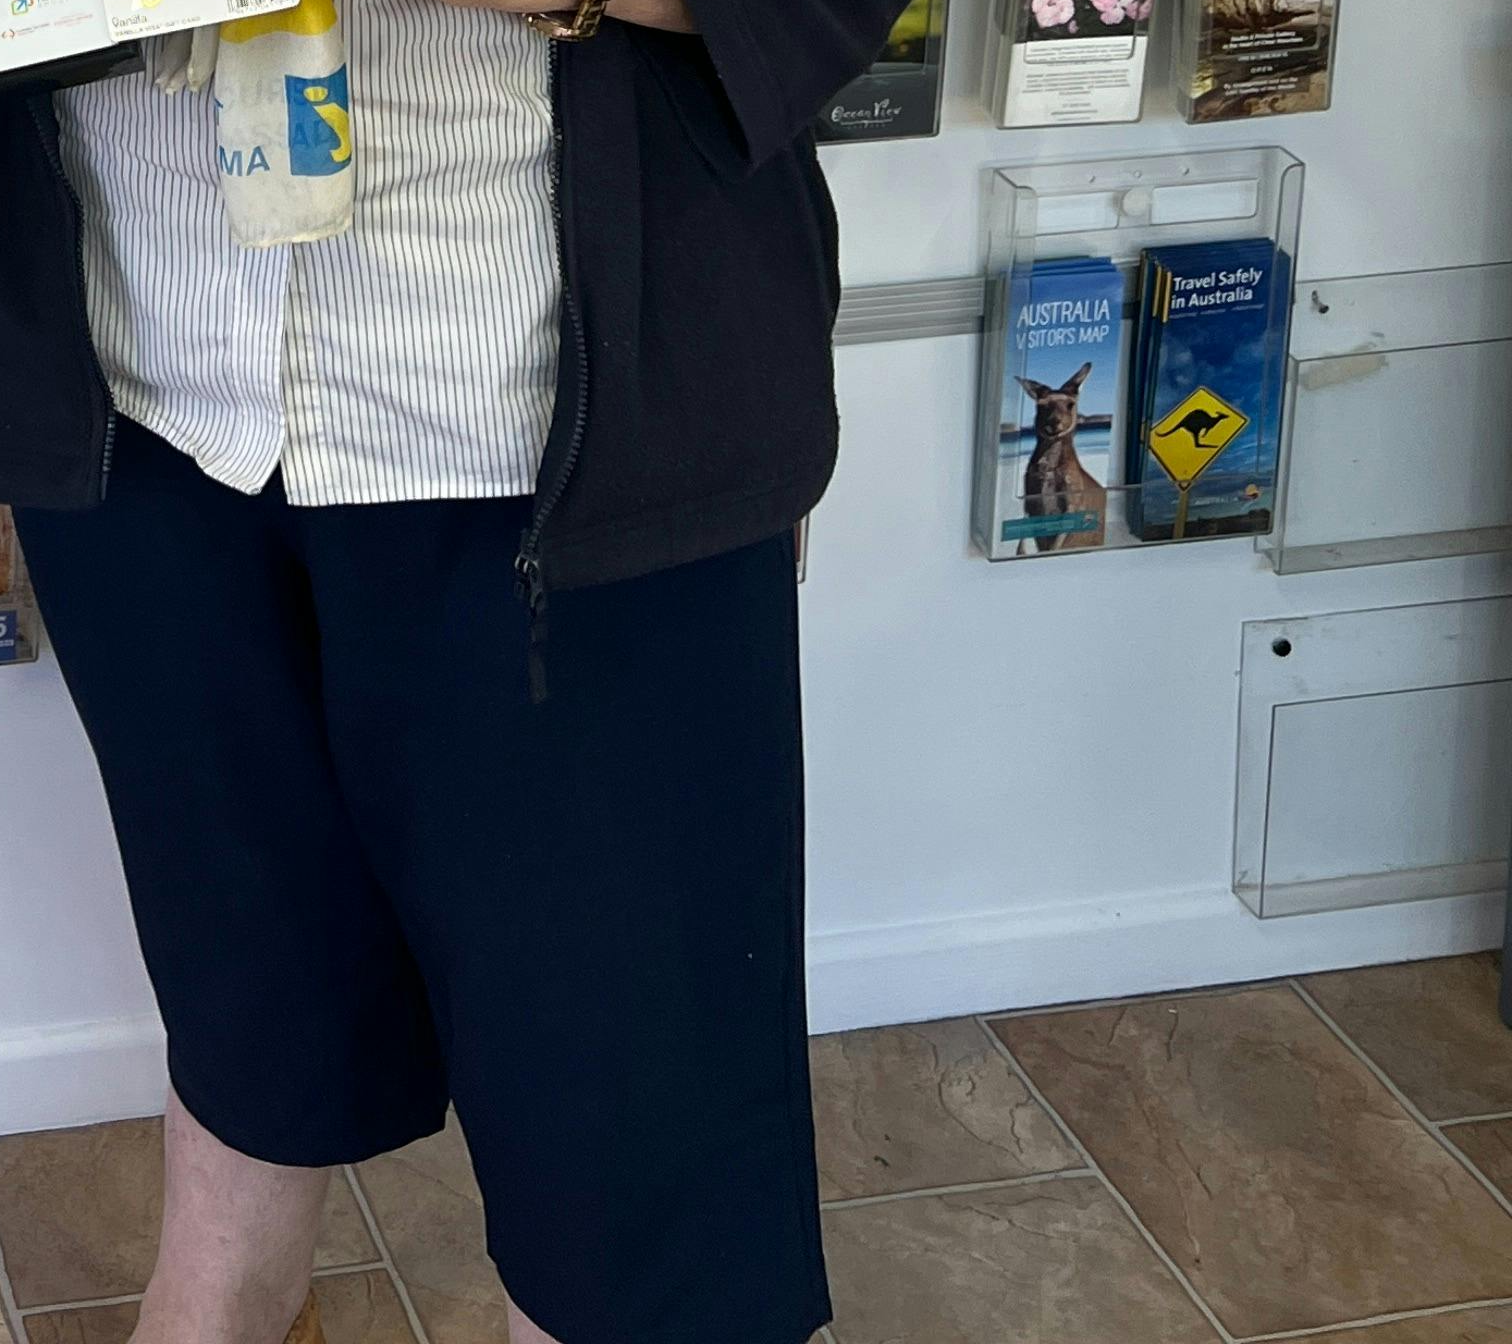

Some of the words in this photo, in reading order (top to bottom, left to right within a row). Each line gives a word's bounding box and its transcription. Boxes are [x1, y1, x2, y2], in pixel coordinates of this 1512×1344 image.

[1173, 272, 1217, 292] Travel
[1218, 268, 1262, 287] Safely
[1172, 295, 1186, 309] in
[1188, 288, 1253, 308] Australia
[1017, 299, 1111, 328] AUSTRALIA
